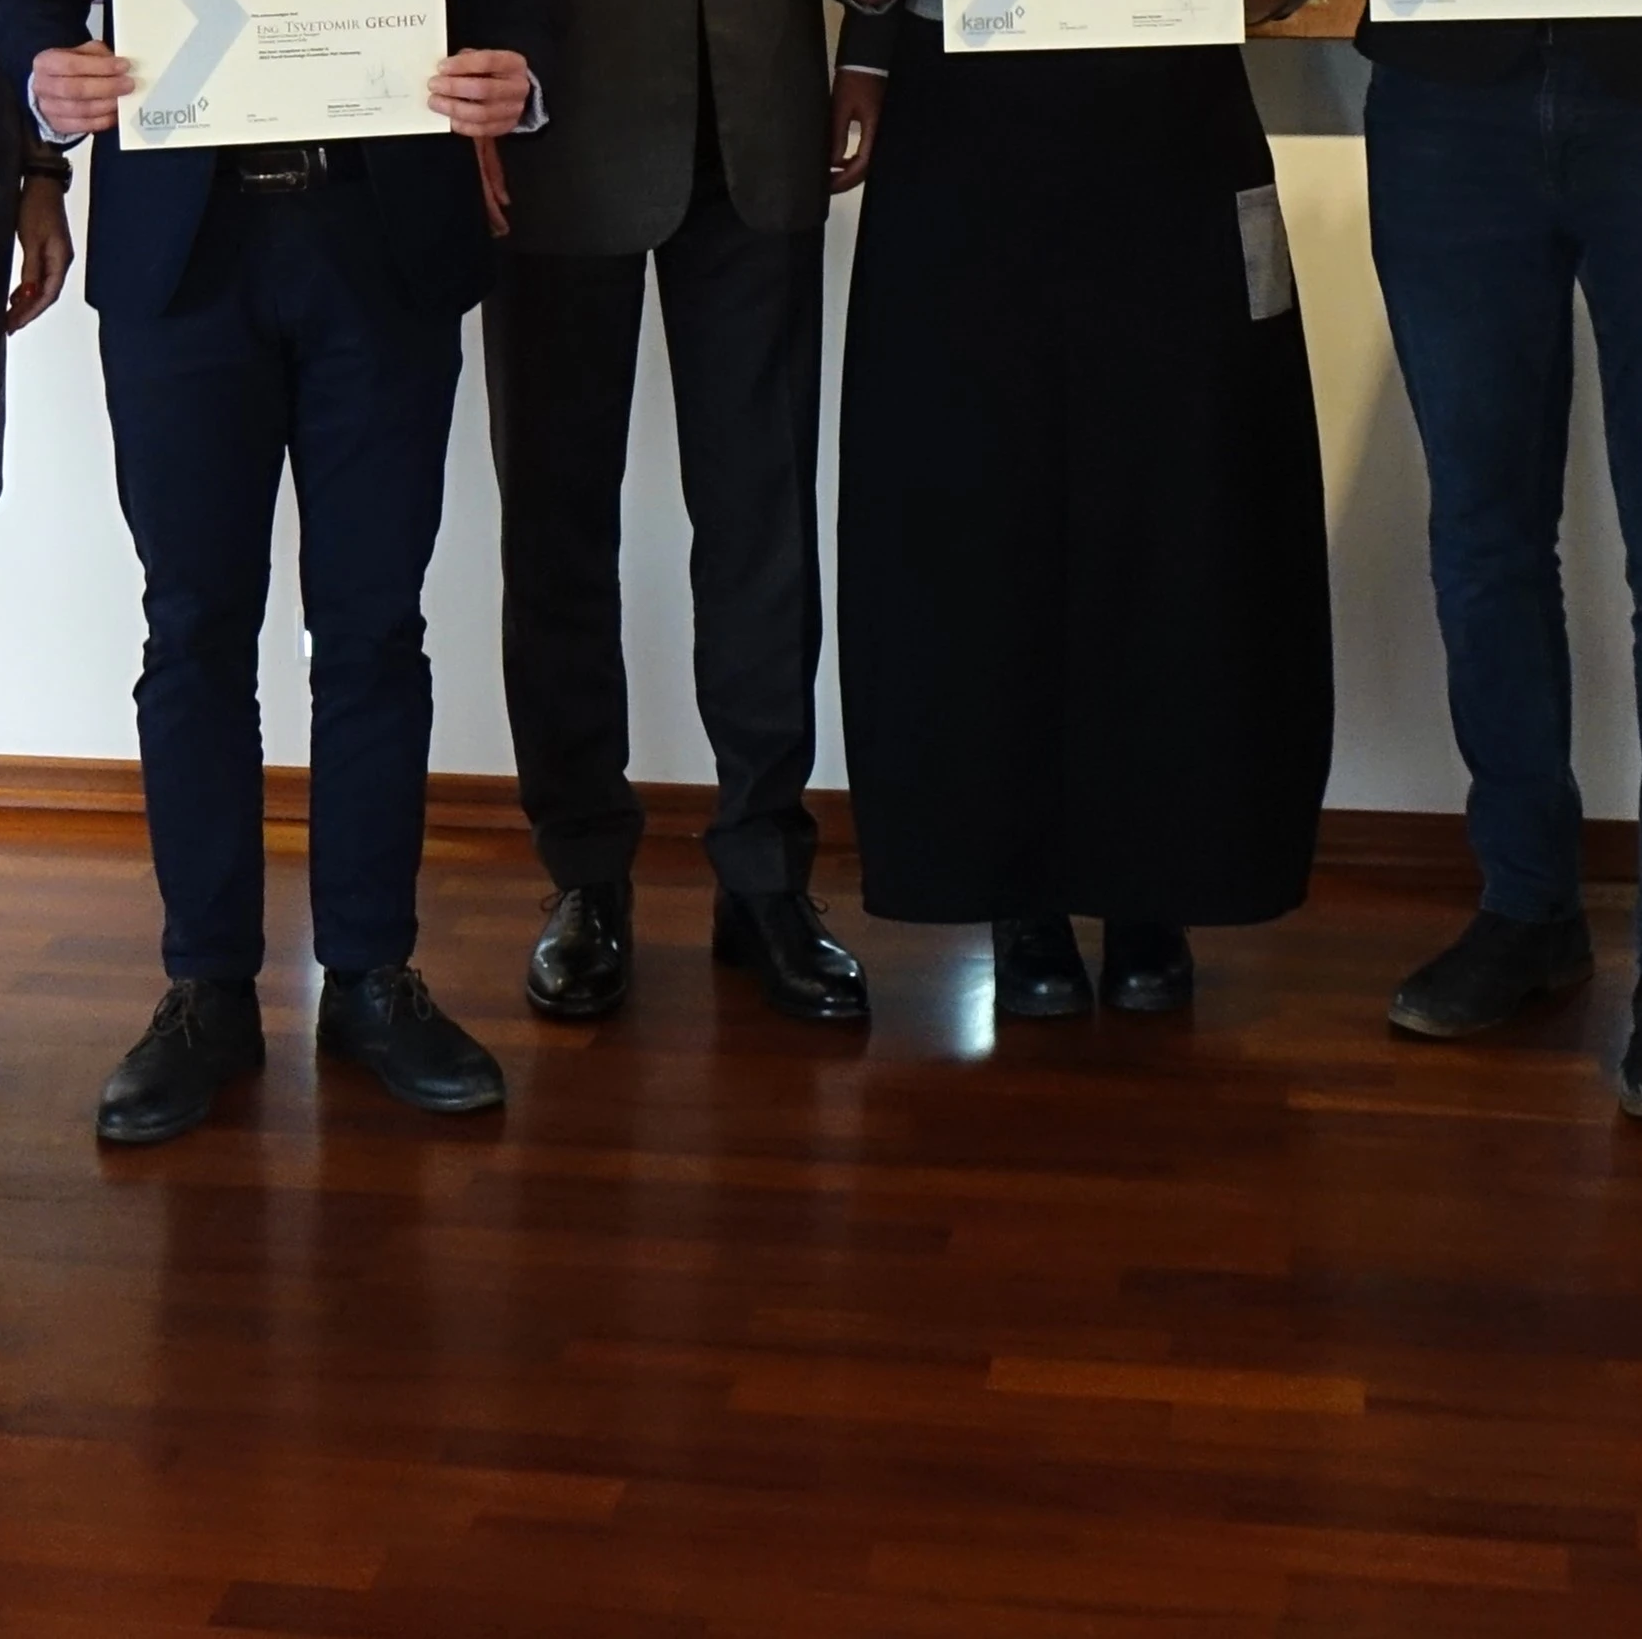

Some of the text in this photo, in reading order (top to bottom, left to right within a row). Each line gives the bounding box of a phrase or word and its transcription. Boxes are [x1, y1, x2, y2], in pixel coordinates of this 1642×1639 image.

[365, 13, 428, 29] GECHEV
[961, 12, 1014, 31] karoll
[138, 104, 197, 127] karoll
